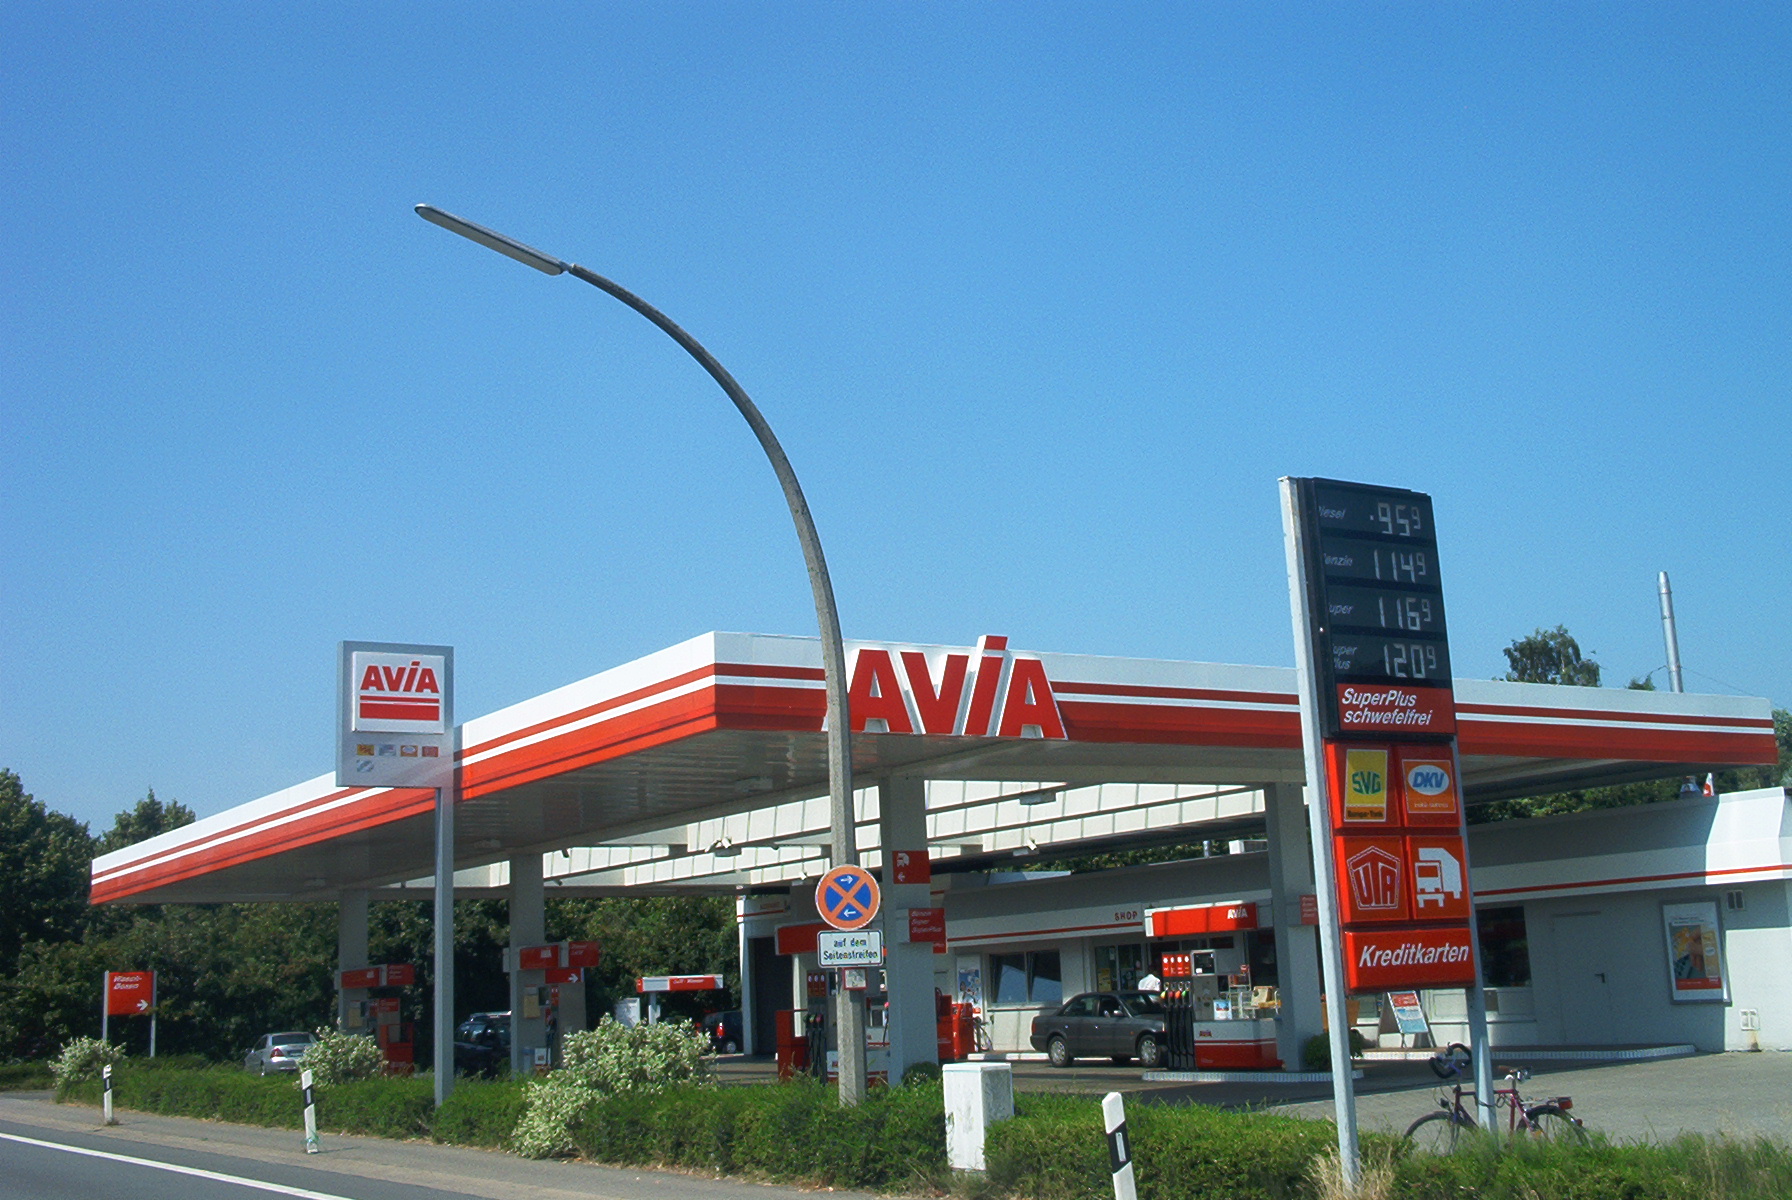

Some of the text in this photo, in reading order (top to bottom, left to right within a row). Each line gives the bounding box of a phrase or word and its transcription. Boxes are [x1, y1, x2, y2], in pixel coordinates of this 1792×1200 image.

[1324, 549, 1427, 584] enzin 1149
[1329, 596, 1432, 631] uper 1169
[1333, 644, 1437, 679] uper 1209
[1341, 687, 1417, 708] SuperPlus
[1343, 707, 1433, 726] schwefelfrei
[1352, 770, 1382, 795] SVG
[1412, 771, 1445, 789] DKV
[1114, 910, 1138, 921] SHOP
[833, 937, 867, 948] auf dem
[823, 949, 878, 960] Seitenstreifen
[1359, 942, 1469, 967] Kreditkarten
